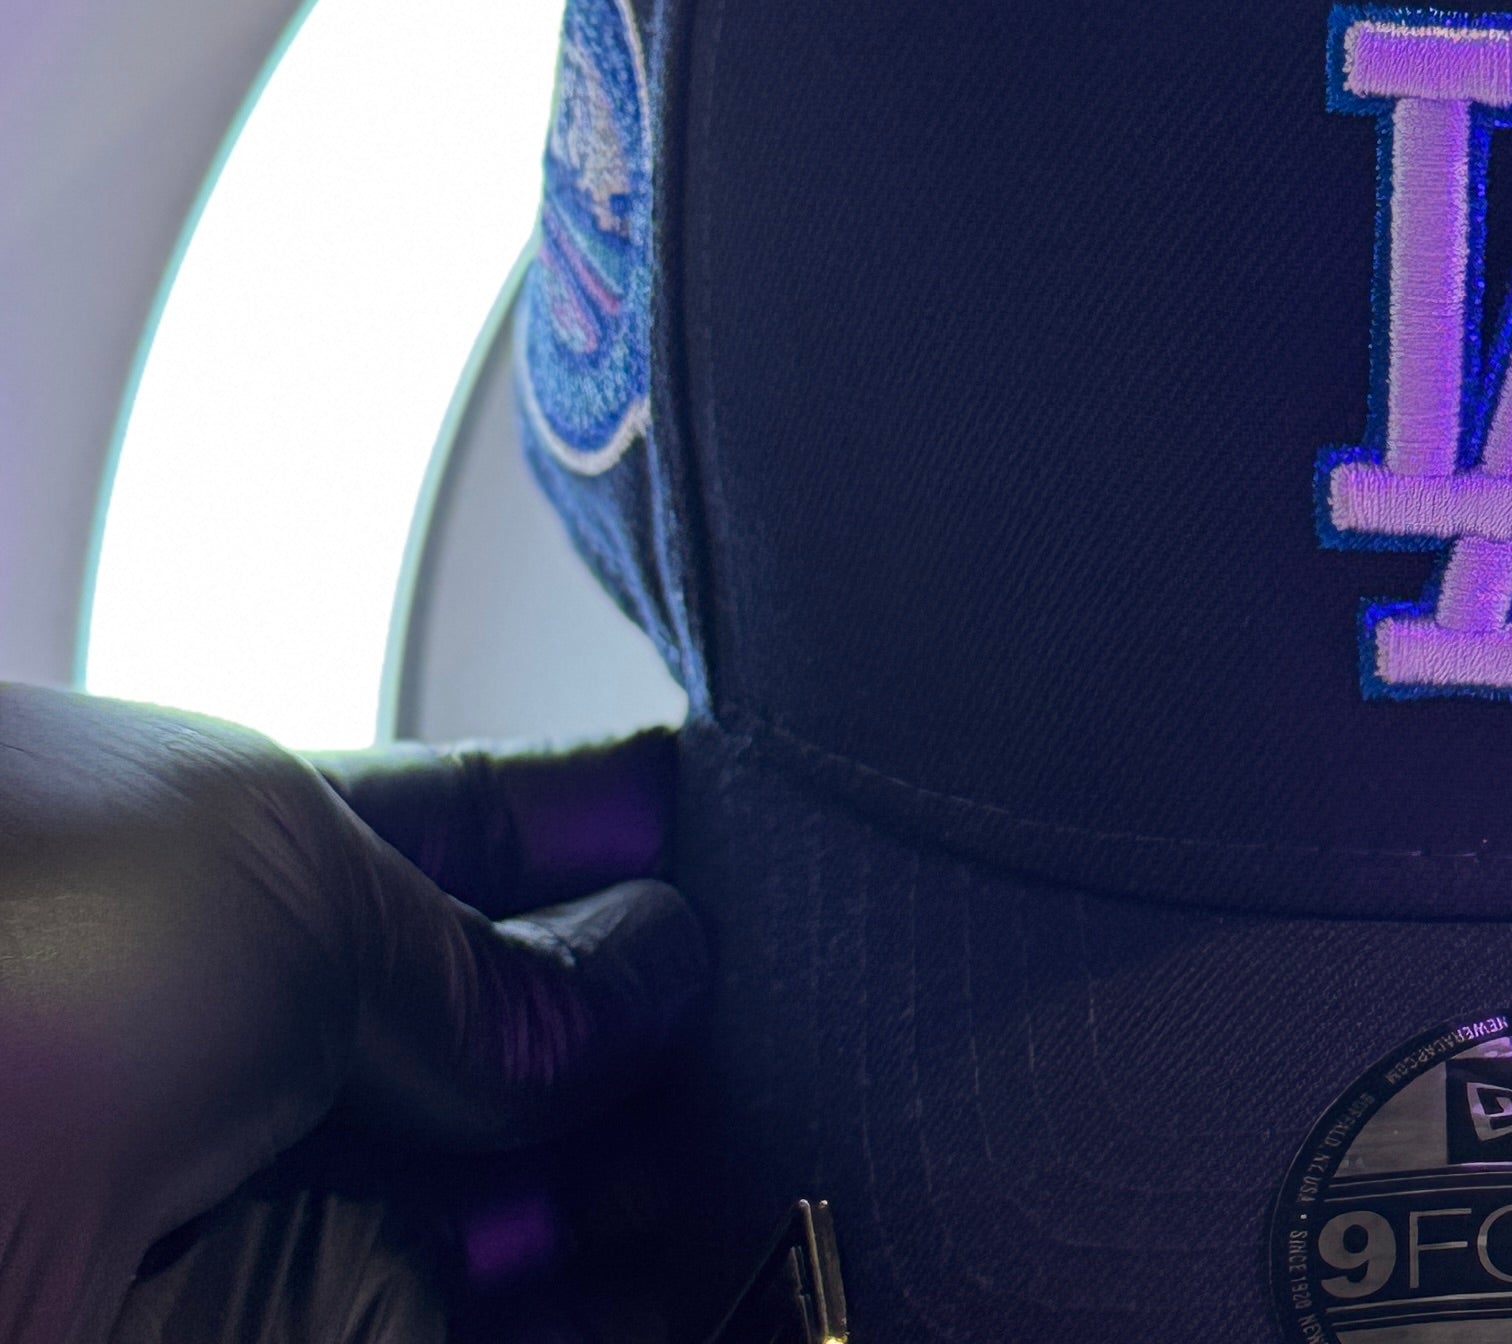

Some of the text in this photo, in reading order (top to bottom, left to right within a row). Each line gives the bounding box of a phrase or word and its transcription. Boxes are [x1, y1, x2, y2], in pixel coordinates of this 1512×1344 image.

[1298, 1175, 1319, 1202] USA
[1288, 1229, 1308, 1273] SINCE
[1291, 1276, 1313, 1309] 1920
